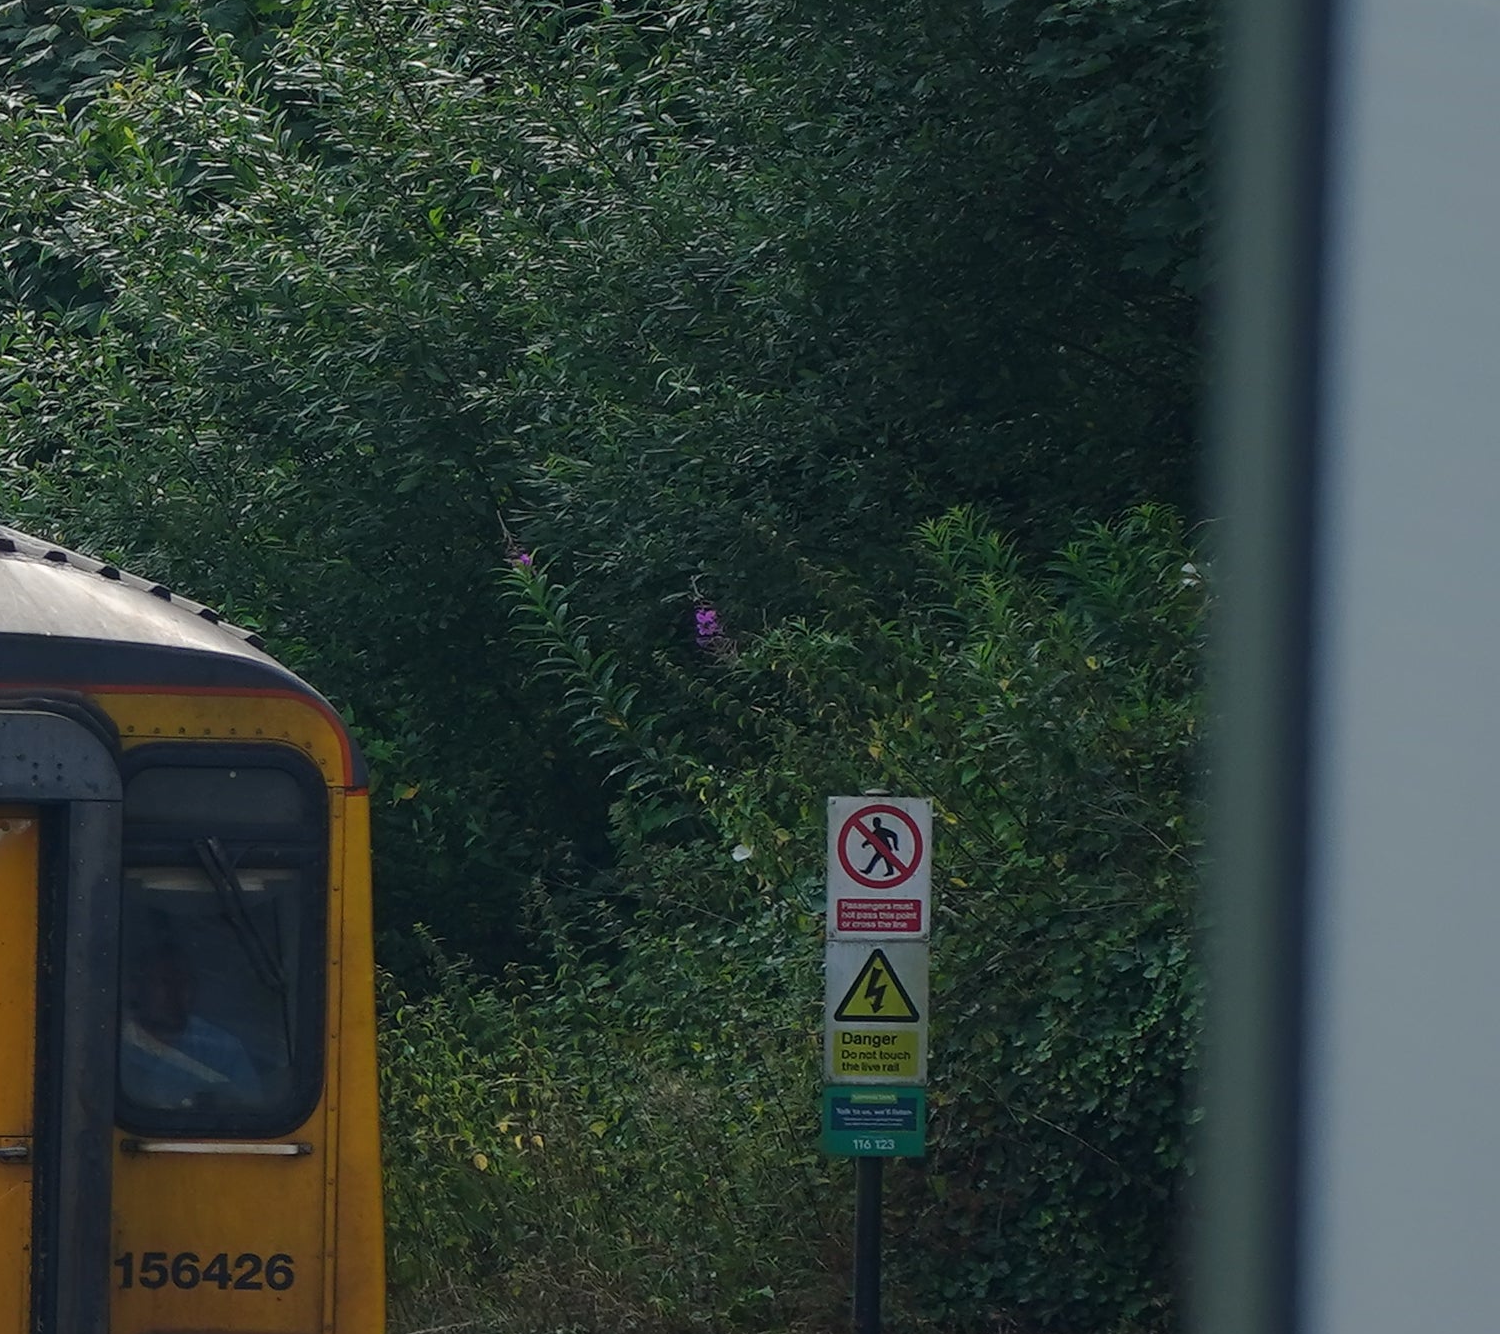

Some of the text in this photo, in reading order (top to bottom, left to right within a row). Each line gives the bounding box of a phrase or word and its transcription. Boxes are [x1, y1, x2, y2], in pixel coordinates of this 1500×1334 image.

[842, 901, 892, 911] Passengers
[842, 911, 856, 919] not
[857, 912, 878, 920] pass
[842, 1032, 898, 1048] Danger
[841, 1049, 911, 1060] Do not touch
[842, 1062, 900, 1072] the live rail
[853, 1139, 895, 1150] 116 123
[113, 1251, 295, 1291] 156426
